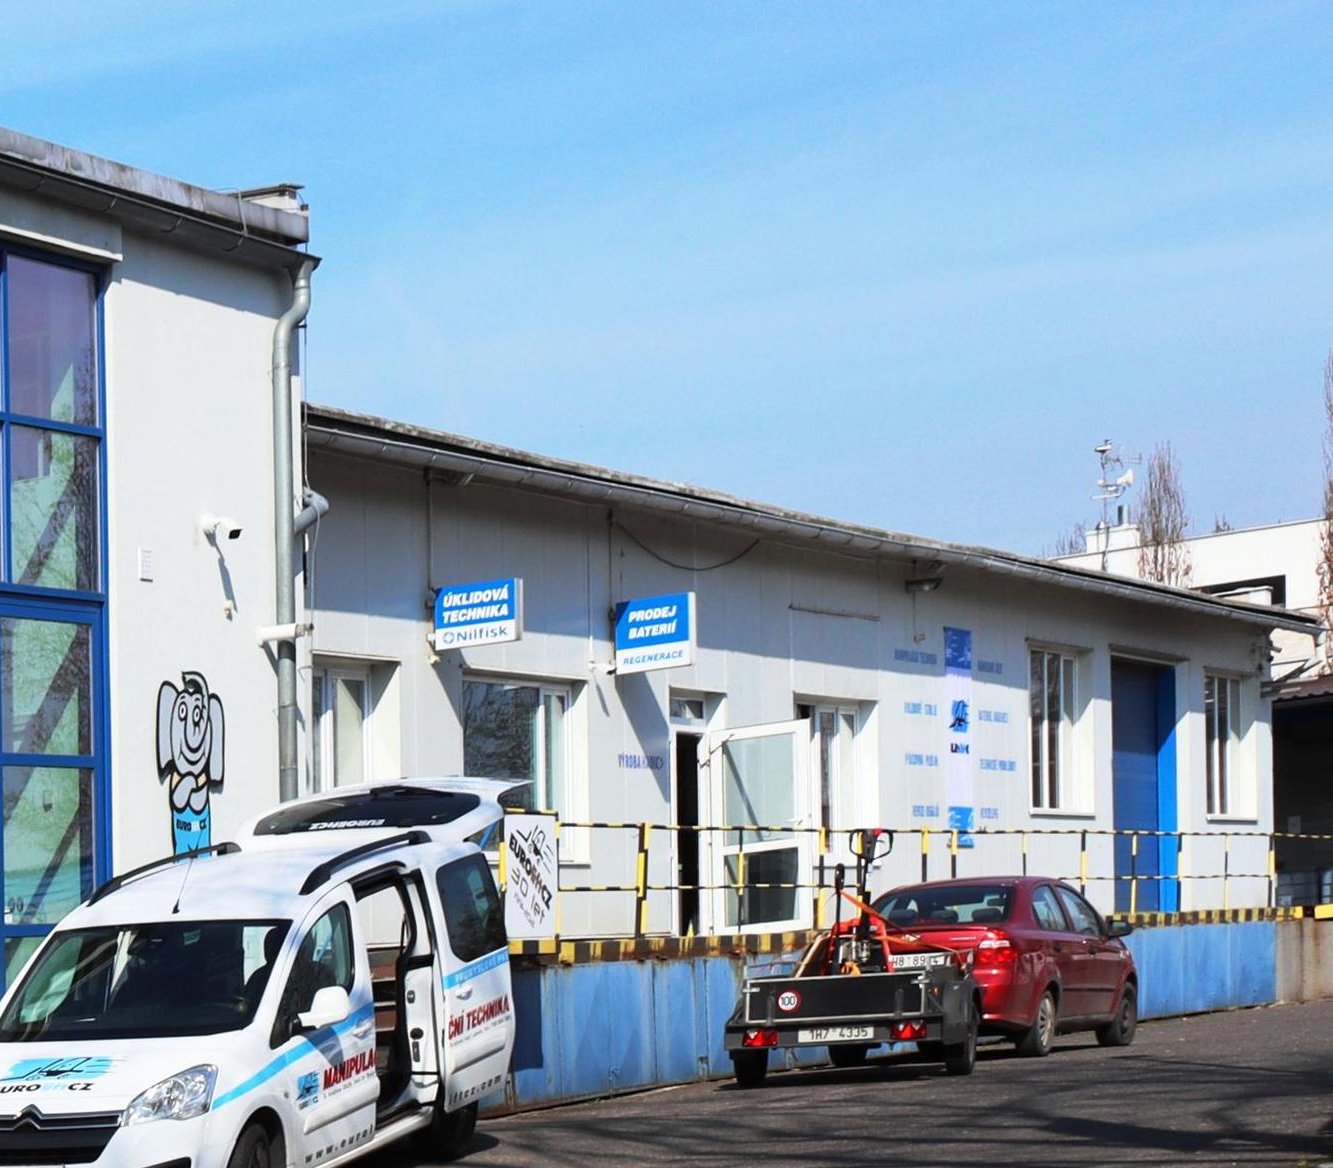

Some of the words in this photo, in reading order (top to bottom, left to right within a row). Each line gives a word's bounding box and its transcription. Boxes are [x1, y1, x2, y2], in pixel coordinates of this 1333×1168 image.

[443, 584, 509, 608] ÚKLIDOVÁ
[442, 603, 509, 624] TECHNIKA
[628, 605, 678, 624] PRODEJ
[456, 625, 509, 642] Nilfisk
[628, 619, 678, 640] BATERIÍ
[623, 650, 684, 665] REGENERACE
[466, 993, 510, 1031] TECHNIKA
[839, 1027, 868, 1038] 4335
